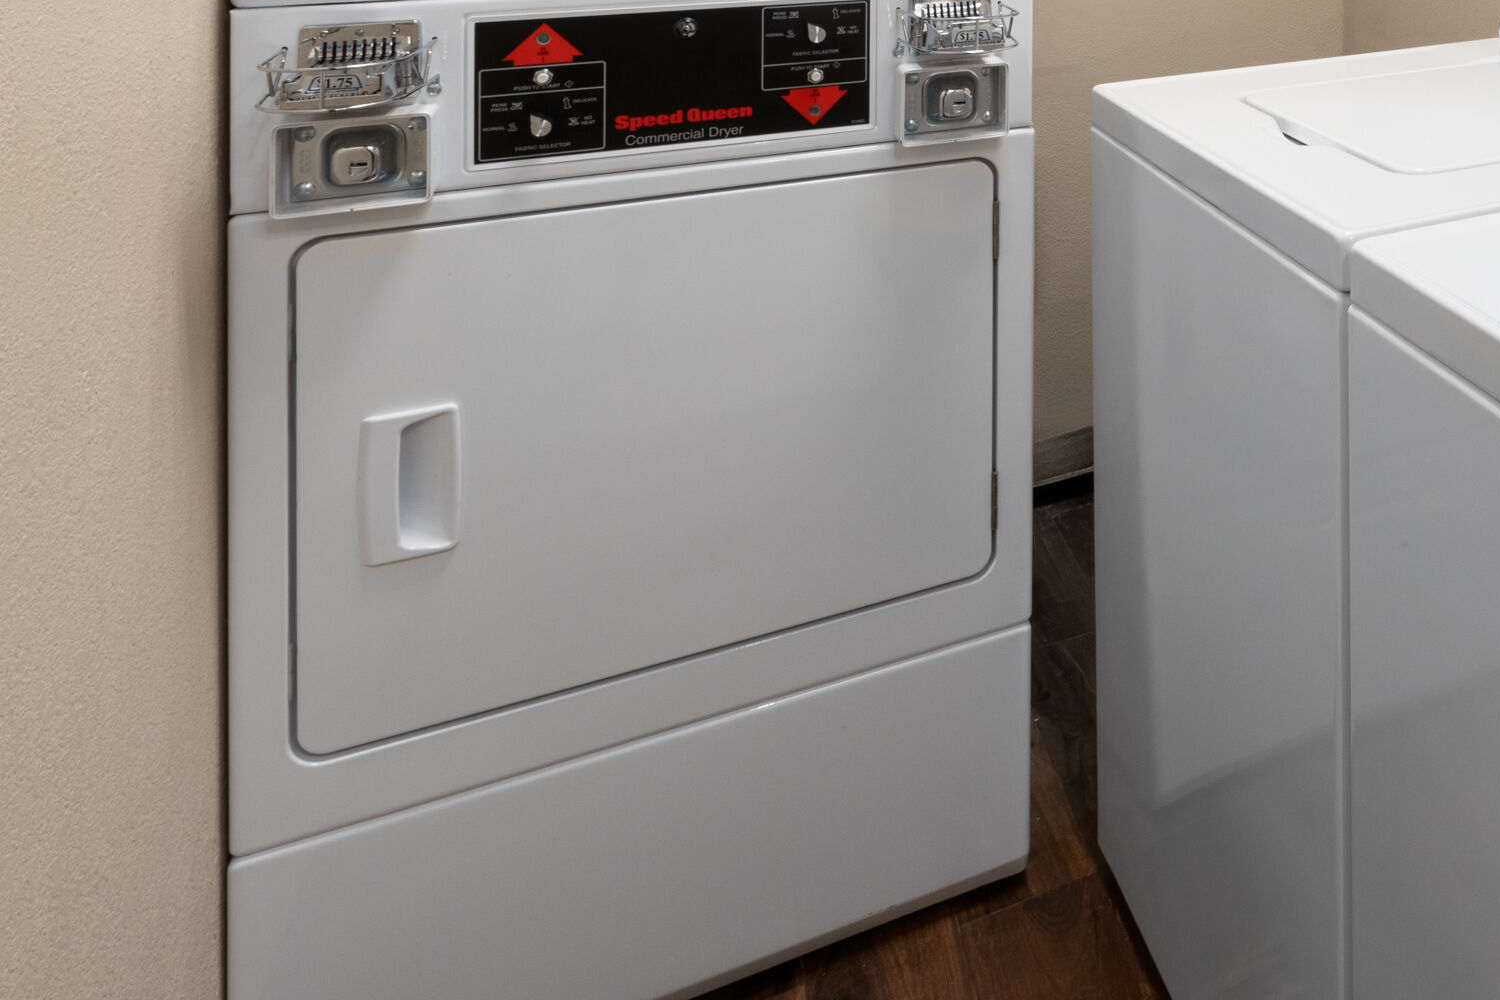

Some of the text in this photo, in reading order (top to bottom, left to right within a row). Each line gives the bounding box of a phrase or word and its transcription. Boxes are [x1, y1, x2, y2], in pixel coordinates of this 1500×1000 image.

[614, 107, 753, 131] Speed Queen
[625, 126, 744, 146] Commercial Dryer
